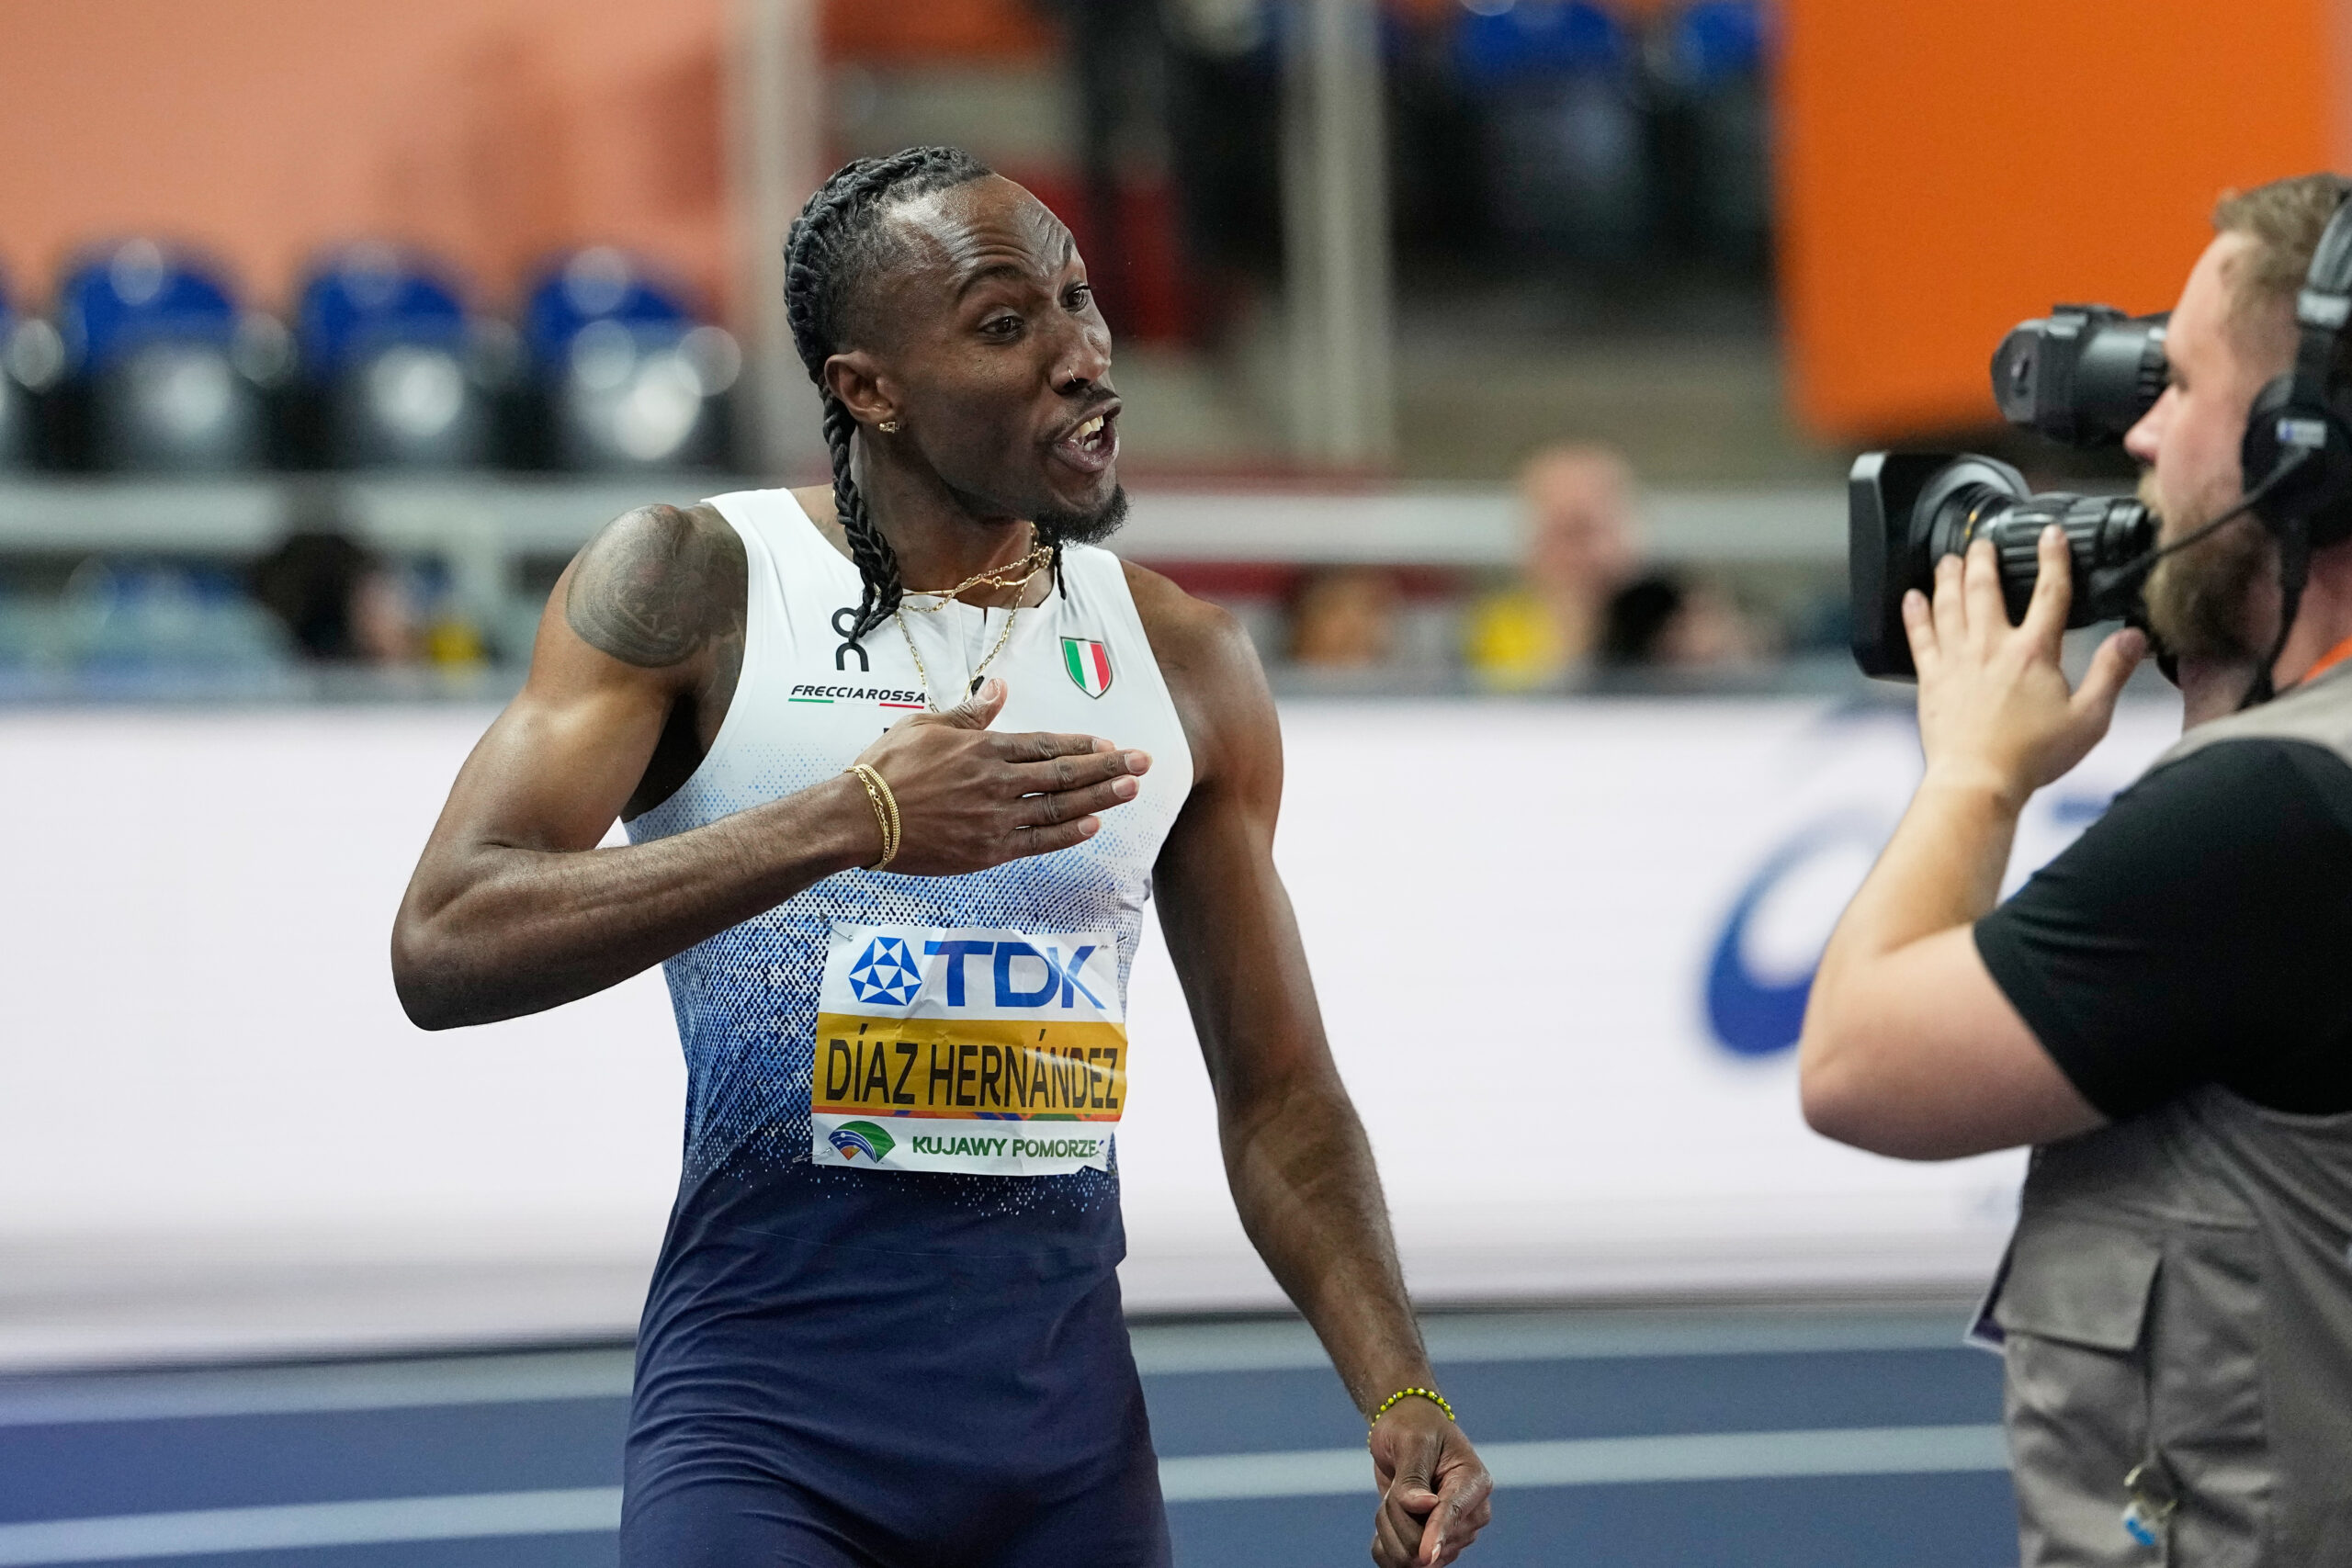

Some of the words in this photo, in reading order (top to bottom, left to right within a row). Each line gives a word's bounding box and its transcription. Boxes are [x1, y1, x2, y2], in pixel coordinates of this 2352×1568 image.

[791, 684, 926, 704] FRECCIAROSSA
[923, 940, 1107, 1010] TDK
[825, 1022, 919, 1105] DÍAZ
[927, 1028, 1119, 1110] HERNÁNDEZ
[912, 1136, 1008, 1157] KUJAWY
